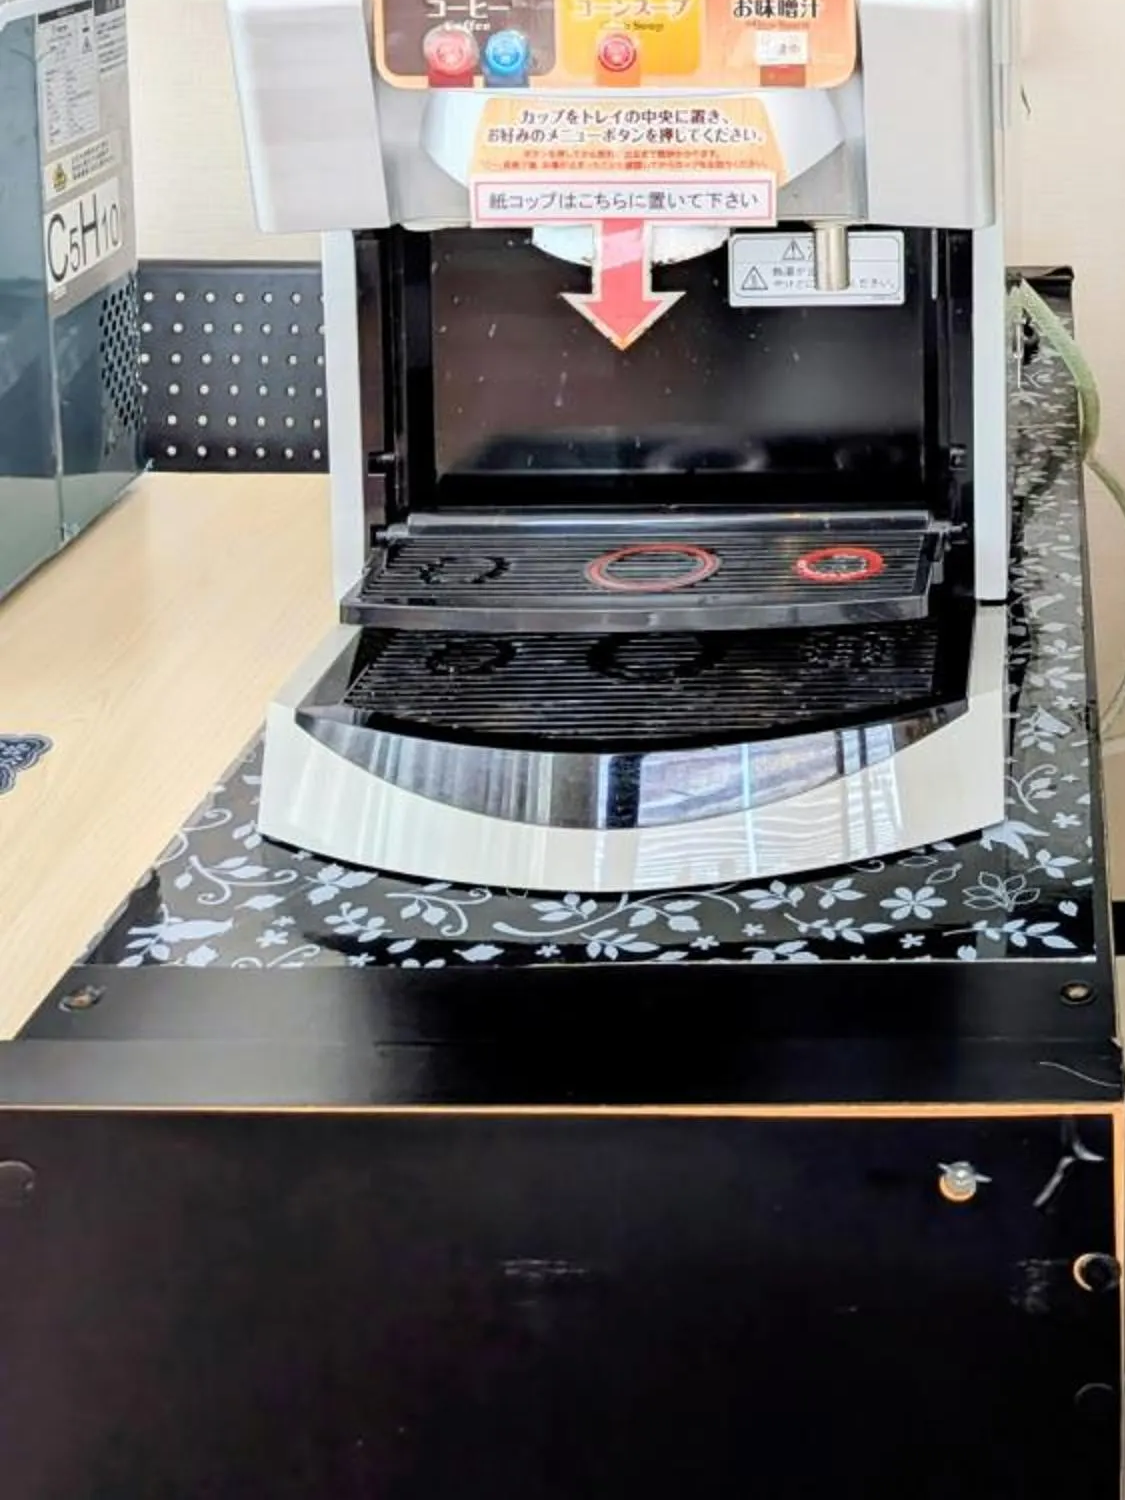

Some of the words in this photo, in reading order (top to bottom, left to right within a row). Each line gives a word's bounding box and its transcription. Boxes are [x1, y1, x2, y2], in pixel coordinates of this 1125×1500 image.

[488, 191, 760, 211] 紙コップはこちらに置いて下さい
